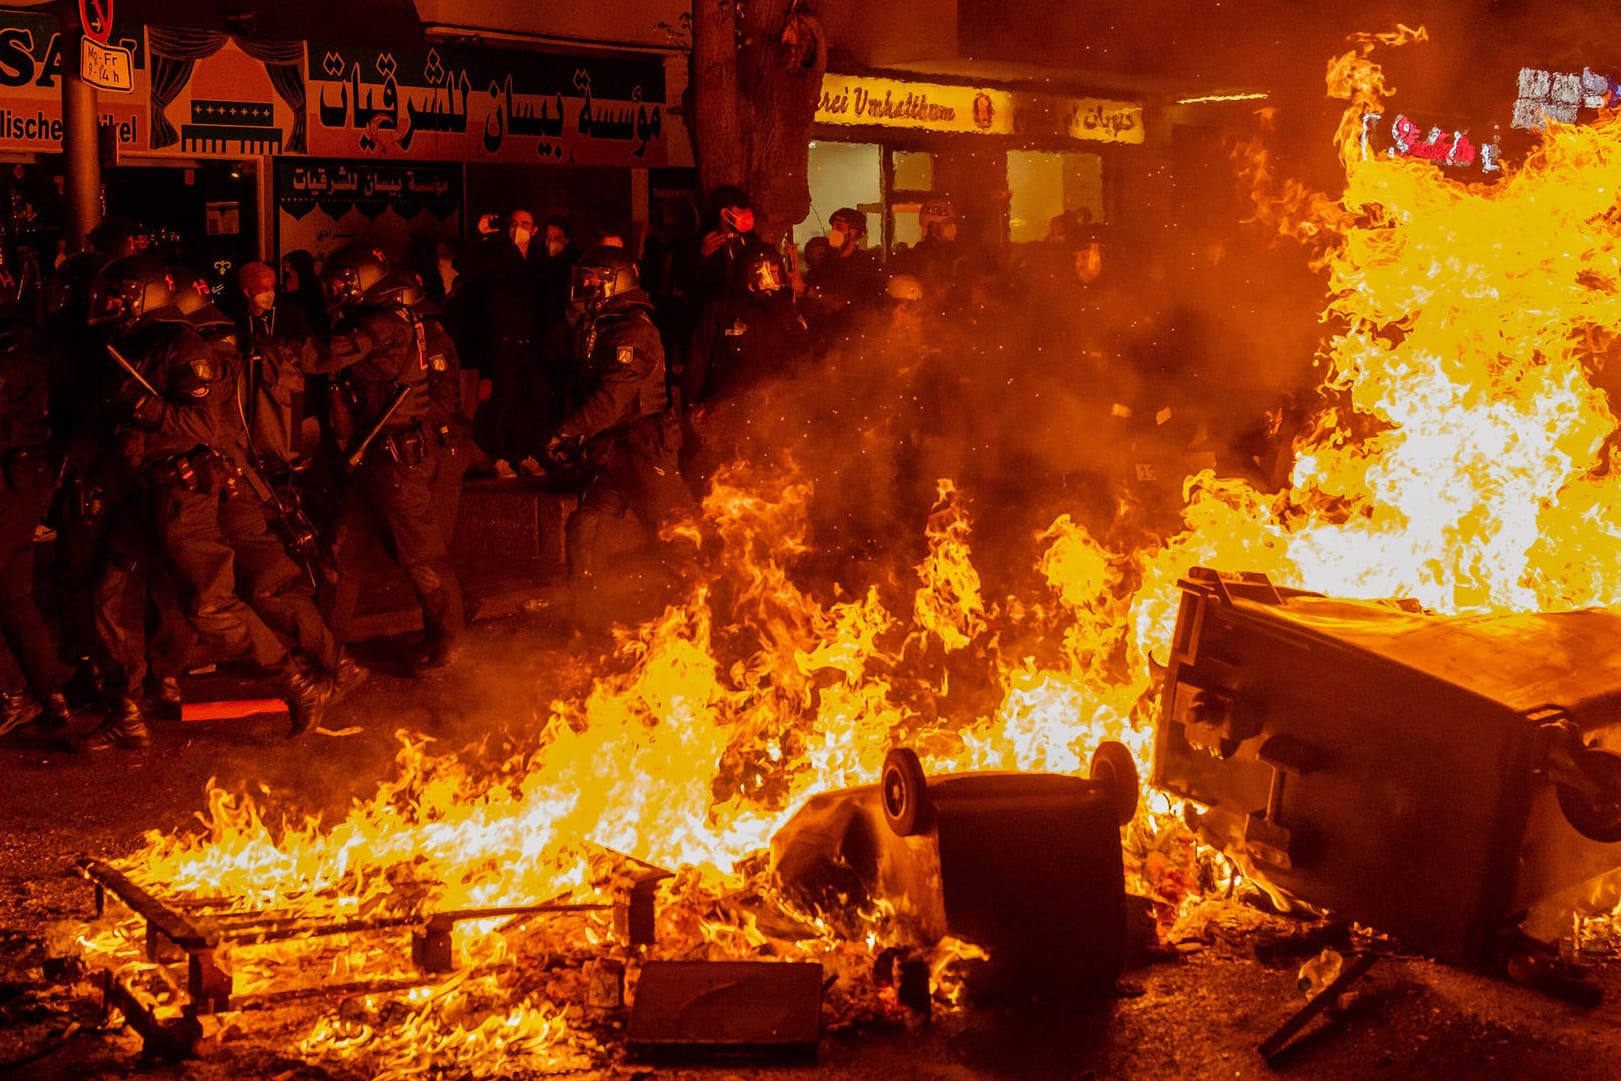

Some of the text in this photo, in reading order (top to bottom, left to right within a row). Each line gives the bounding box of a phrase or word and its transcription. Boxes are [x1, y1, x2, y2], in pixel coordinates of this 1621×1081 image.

[113, 69, 120, 83] h
[319, 48, 661, 159] مؤسسة بيسان للشرقيات
